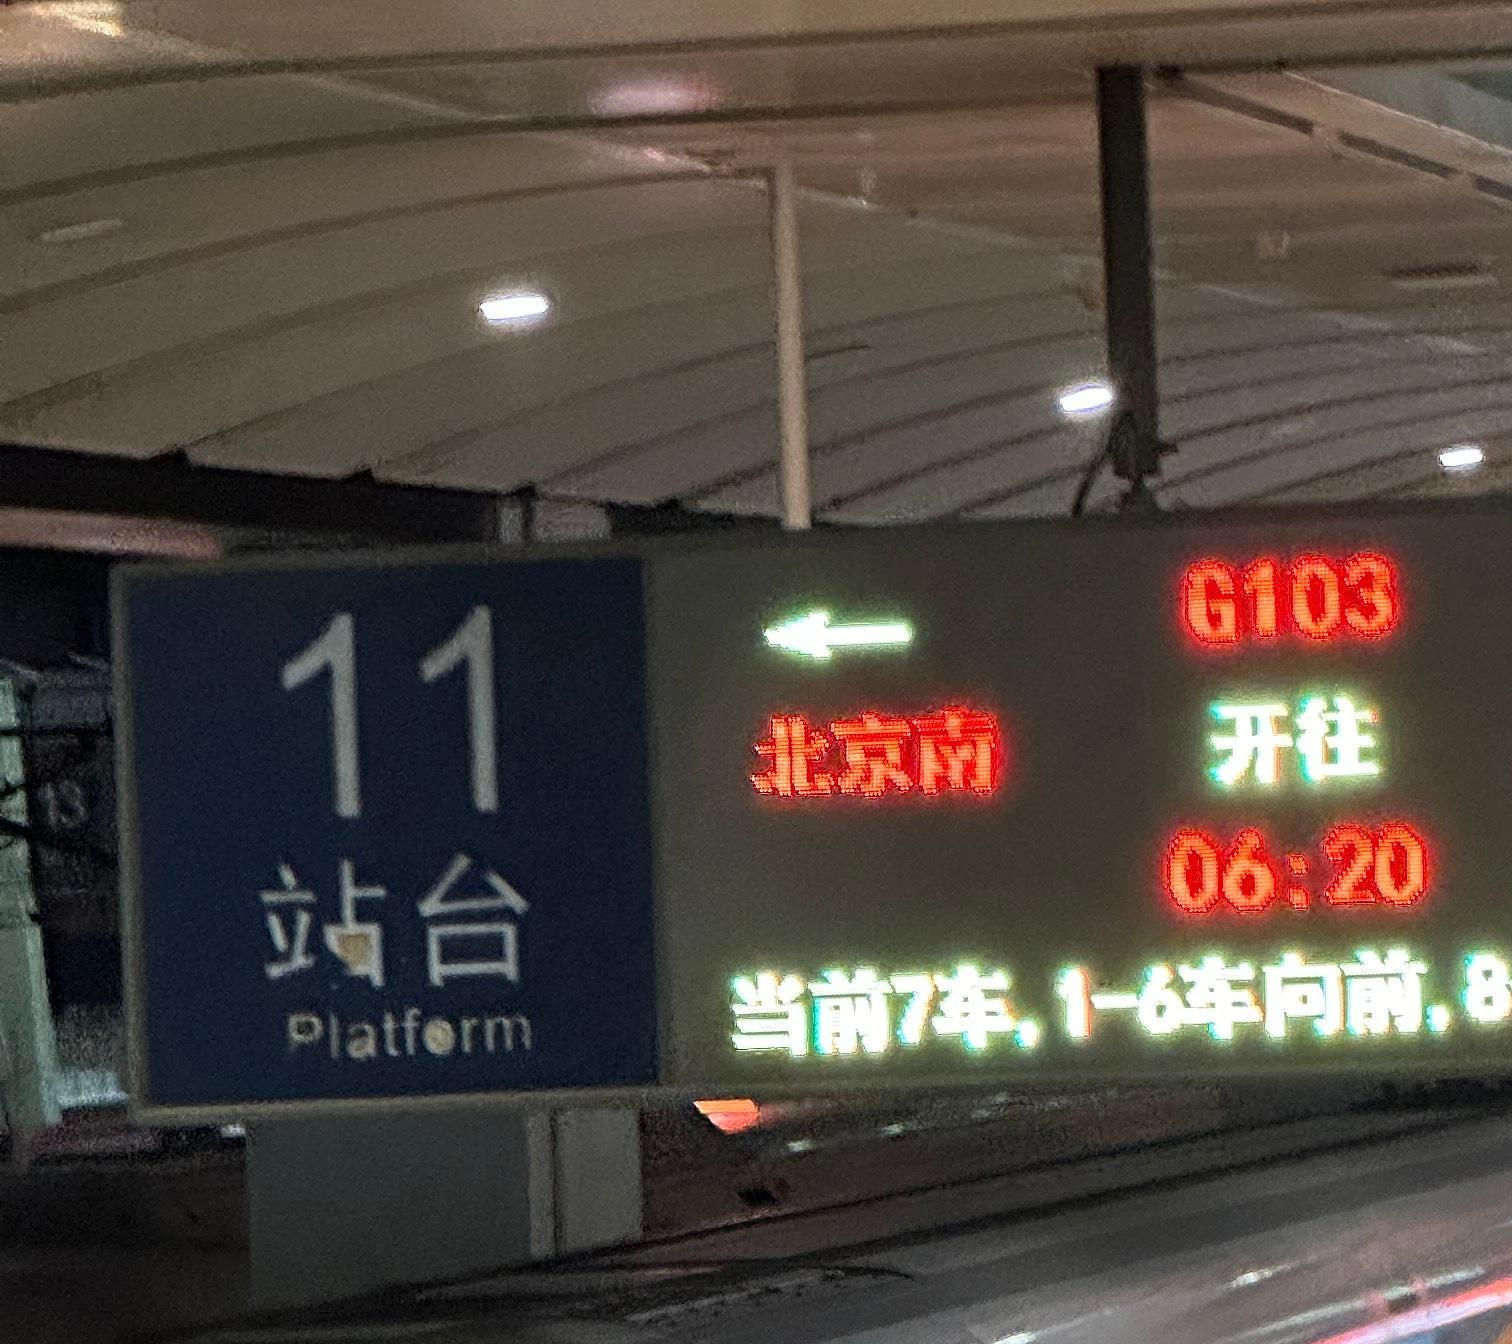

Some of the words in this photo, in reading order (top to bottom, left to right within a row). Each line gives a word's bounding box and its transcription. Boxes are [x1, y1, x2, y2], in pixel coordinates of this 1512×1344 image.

[1180, 552, 1400, 648] G1103
[278, 602, 500, 820] 11
[748, 704, 1002, 800] 北京南
[1208, 688, 1382, 790] 开往
[1164, 824, 1430, 914] 06:20
[258, 852, 530, 988] 站台
[288, 1008, 534, 1062] Platform
